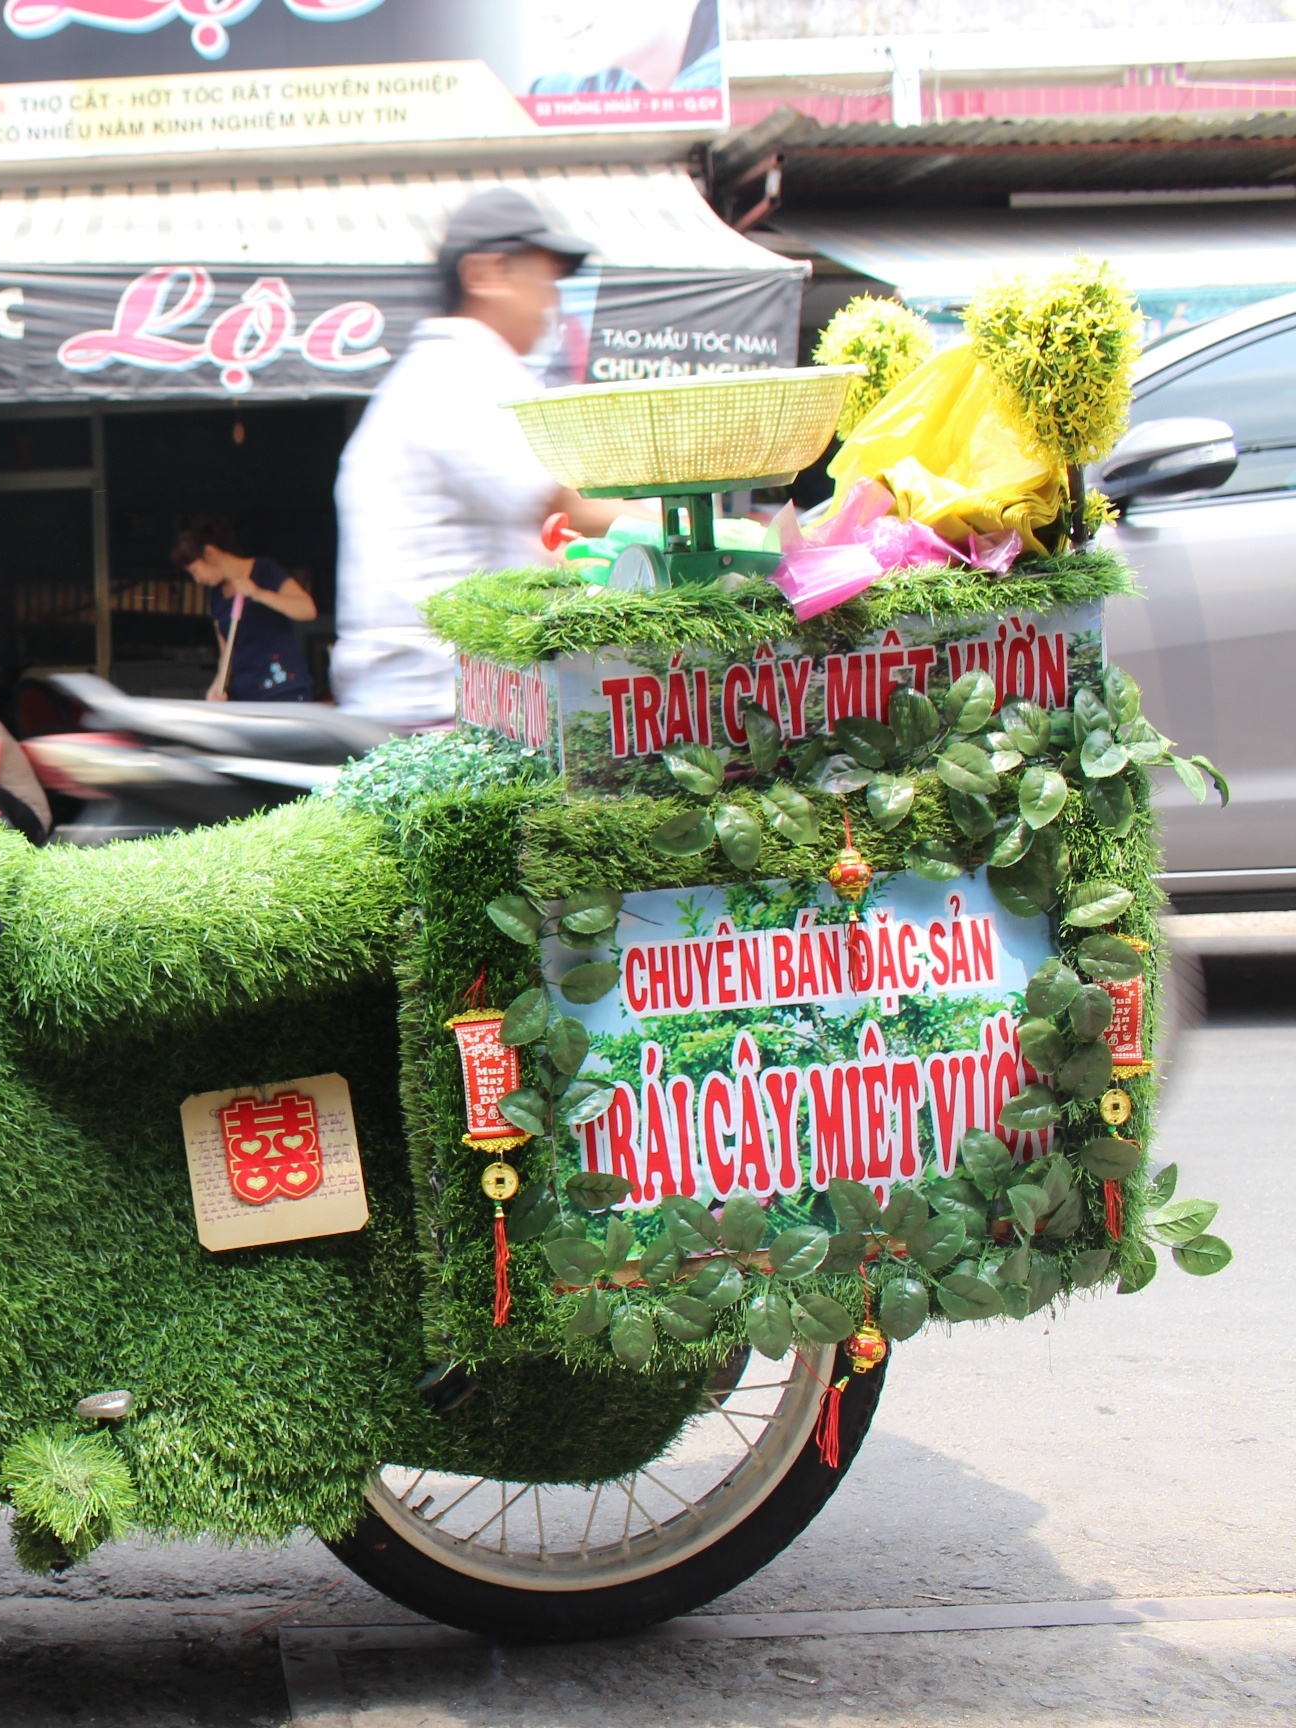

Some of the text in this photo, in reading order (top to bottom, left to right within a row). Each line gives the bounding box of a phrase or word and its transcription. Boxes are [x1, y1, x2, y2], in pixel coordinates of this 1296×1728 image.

[181, 84, 224, 105] TÓC
[281, 78, 370, 100] CHUYÊN
[377, 73, 458, 97] NGHIỆP
[153, 113, 203, 135] KINH
[211, 109, 295, 132] NGHIỆM
[338, 107, 365, 125] UY
[692, 330, 732, 353] TÓC
[734, 334, 777, 356] NAM
[602, 651, 709, 755] TRÁI
[723, 641, 811, 744] CÂY
[626, 895, 994, 1012] CHUYÊN BÁN ĐẶC SẢN
[1112, 1006, 1131, 1016] ay
[475, 1067, 505, 1077] Mua
[476, 1076, 505, 1086] May
[705, 1038, 797, 1193] CÂY
[811, 1026, 919, 1205] MIỆT
